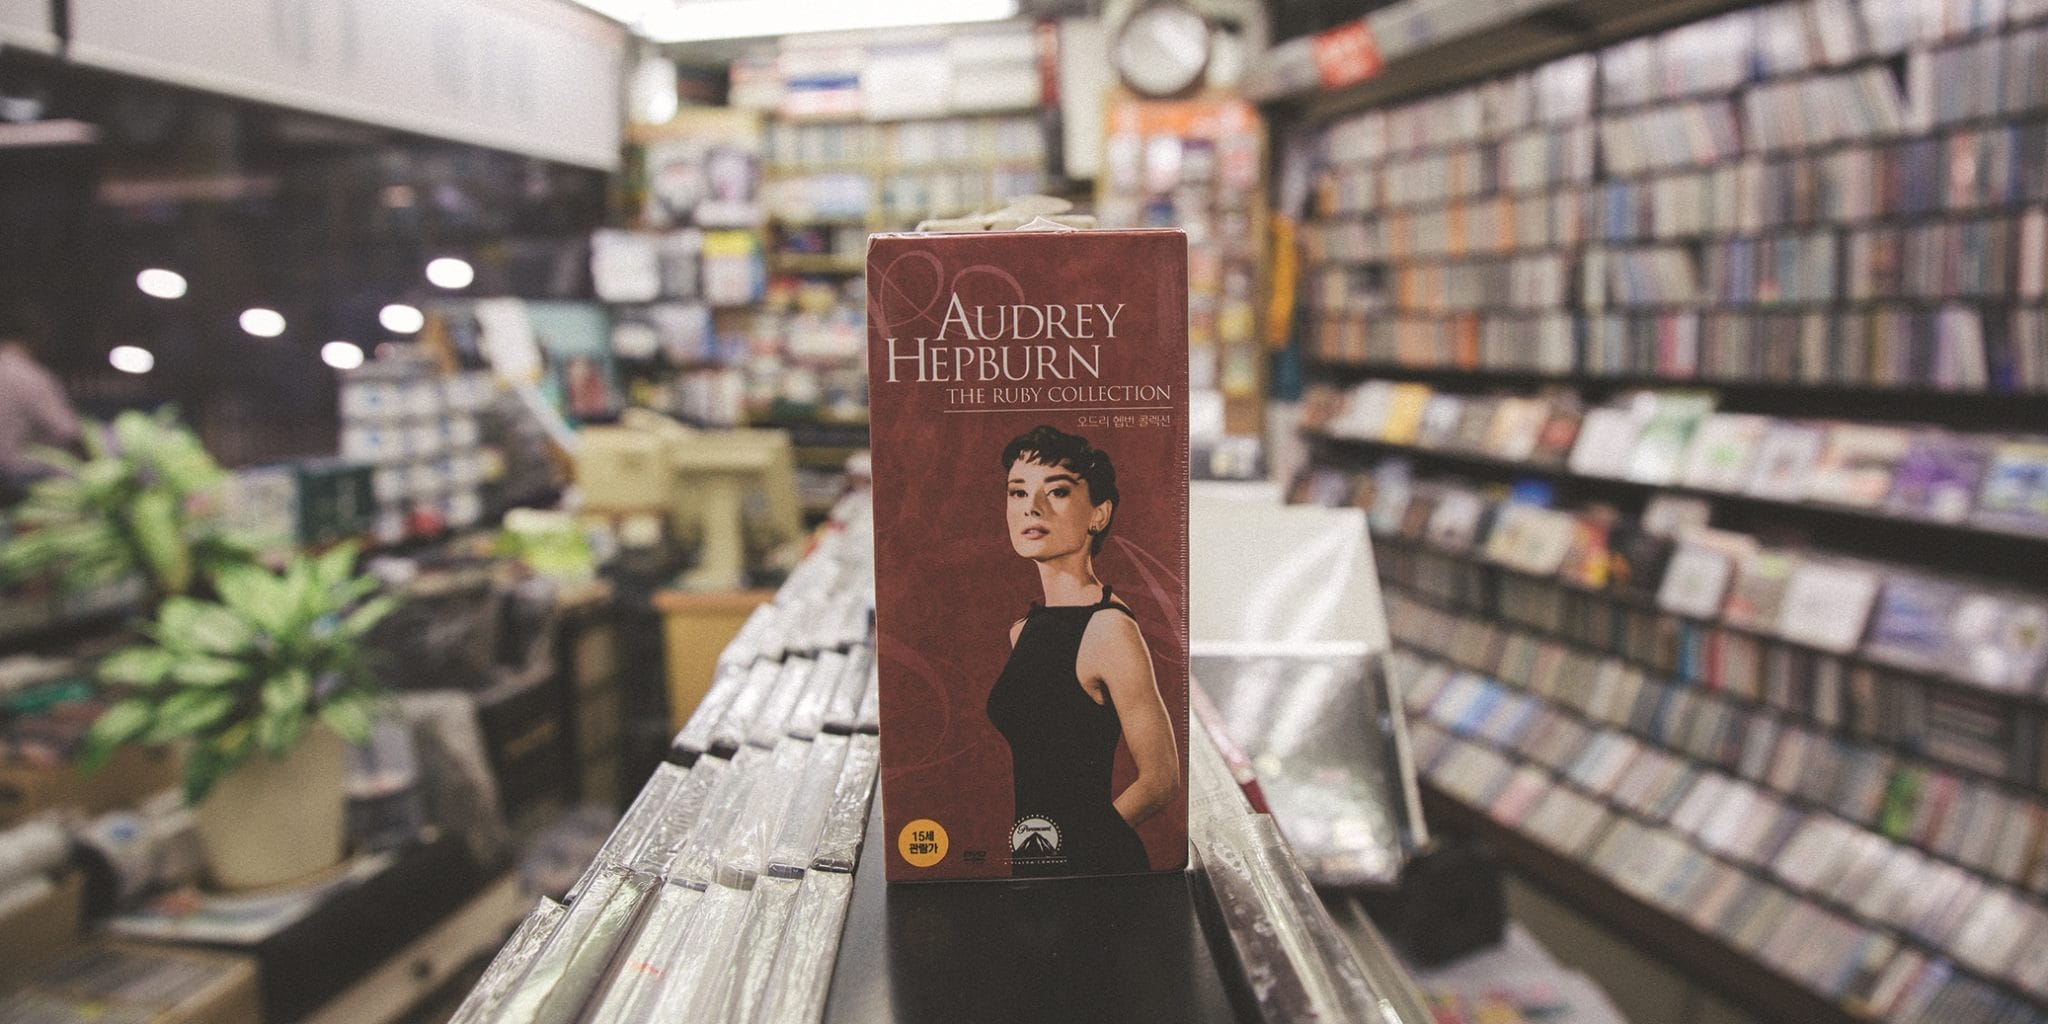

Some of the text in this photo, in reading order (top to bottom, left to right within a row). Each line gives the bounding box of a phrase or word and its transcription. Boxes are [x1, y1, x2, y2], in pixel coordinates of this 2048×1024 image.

[936, 291, 1126, 341] AUDREY
[886, 337, 1101, 382] HEPBURN
[946, 385, 1171, 404] THE RUBY COLLECTION
[1077, 414, 1171, 428] 오드리 헵번 콜렉션
[912, 831, 934, 841] 15세
[909, 842, 938, 854] 관람가
